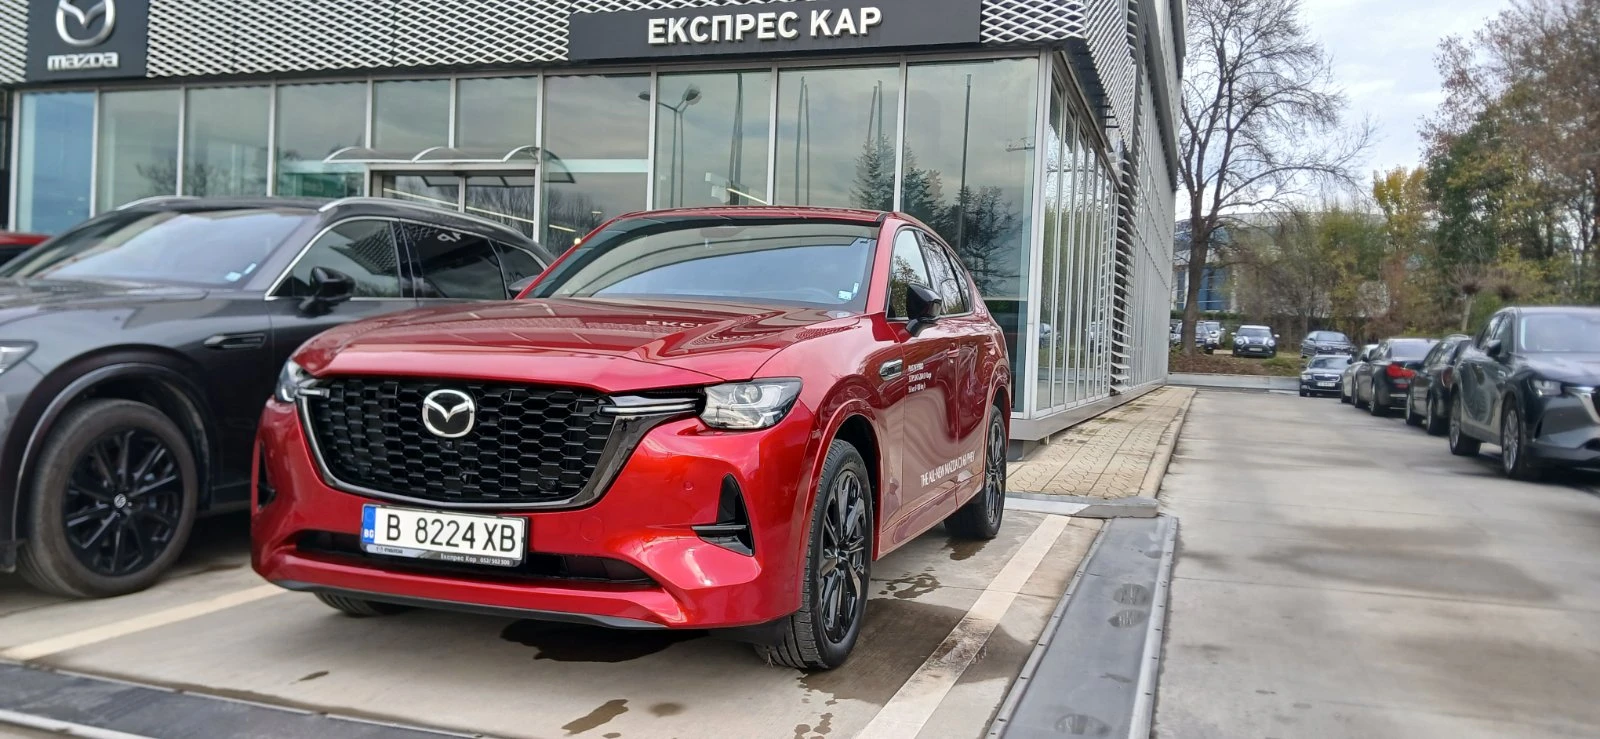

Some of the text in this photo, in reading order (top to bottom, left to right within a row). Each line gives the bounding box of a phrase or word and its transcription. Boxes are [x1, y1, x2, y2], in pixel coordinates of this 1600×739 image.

[647, 6, 882, 45] ЕКСПРЕС КАР
[47, 52, 119, 71] mazda
[363, 528, 374, 539] BG
[386, 513, 516, 552] B 8224 XB
